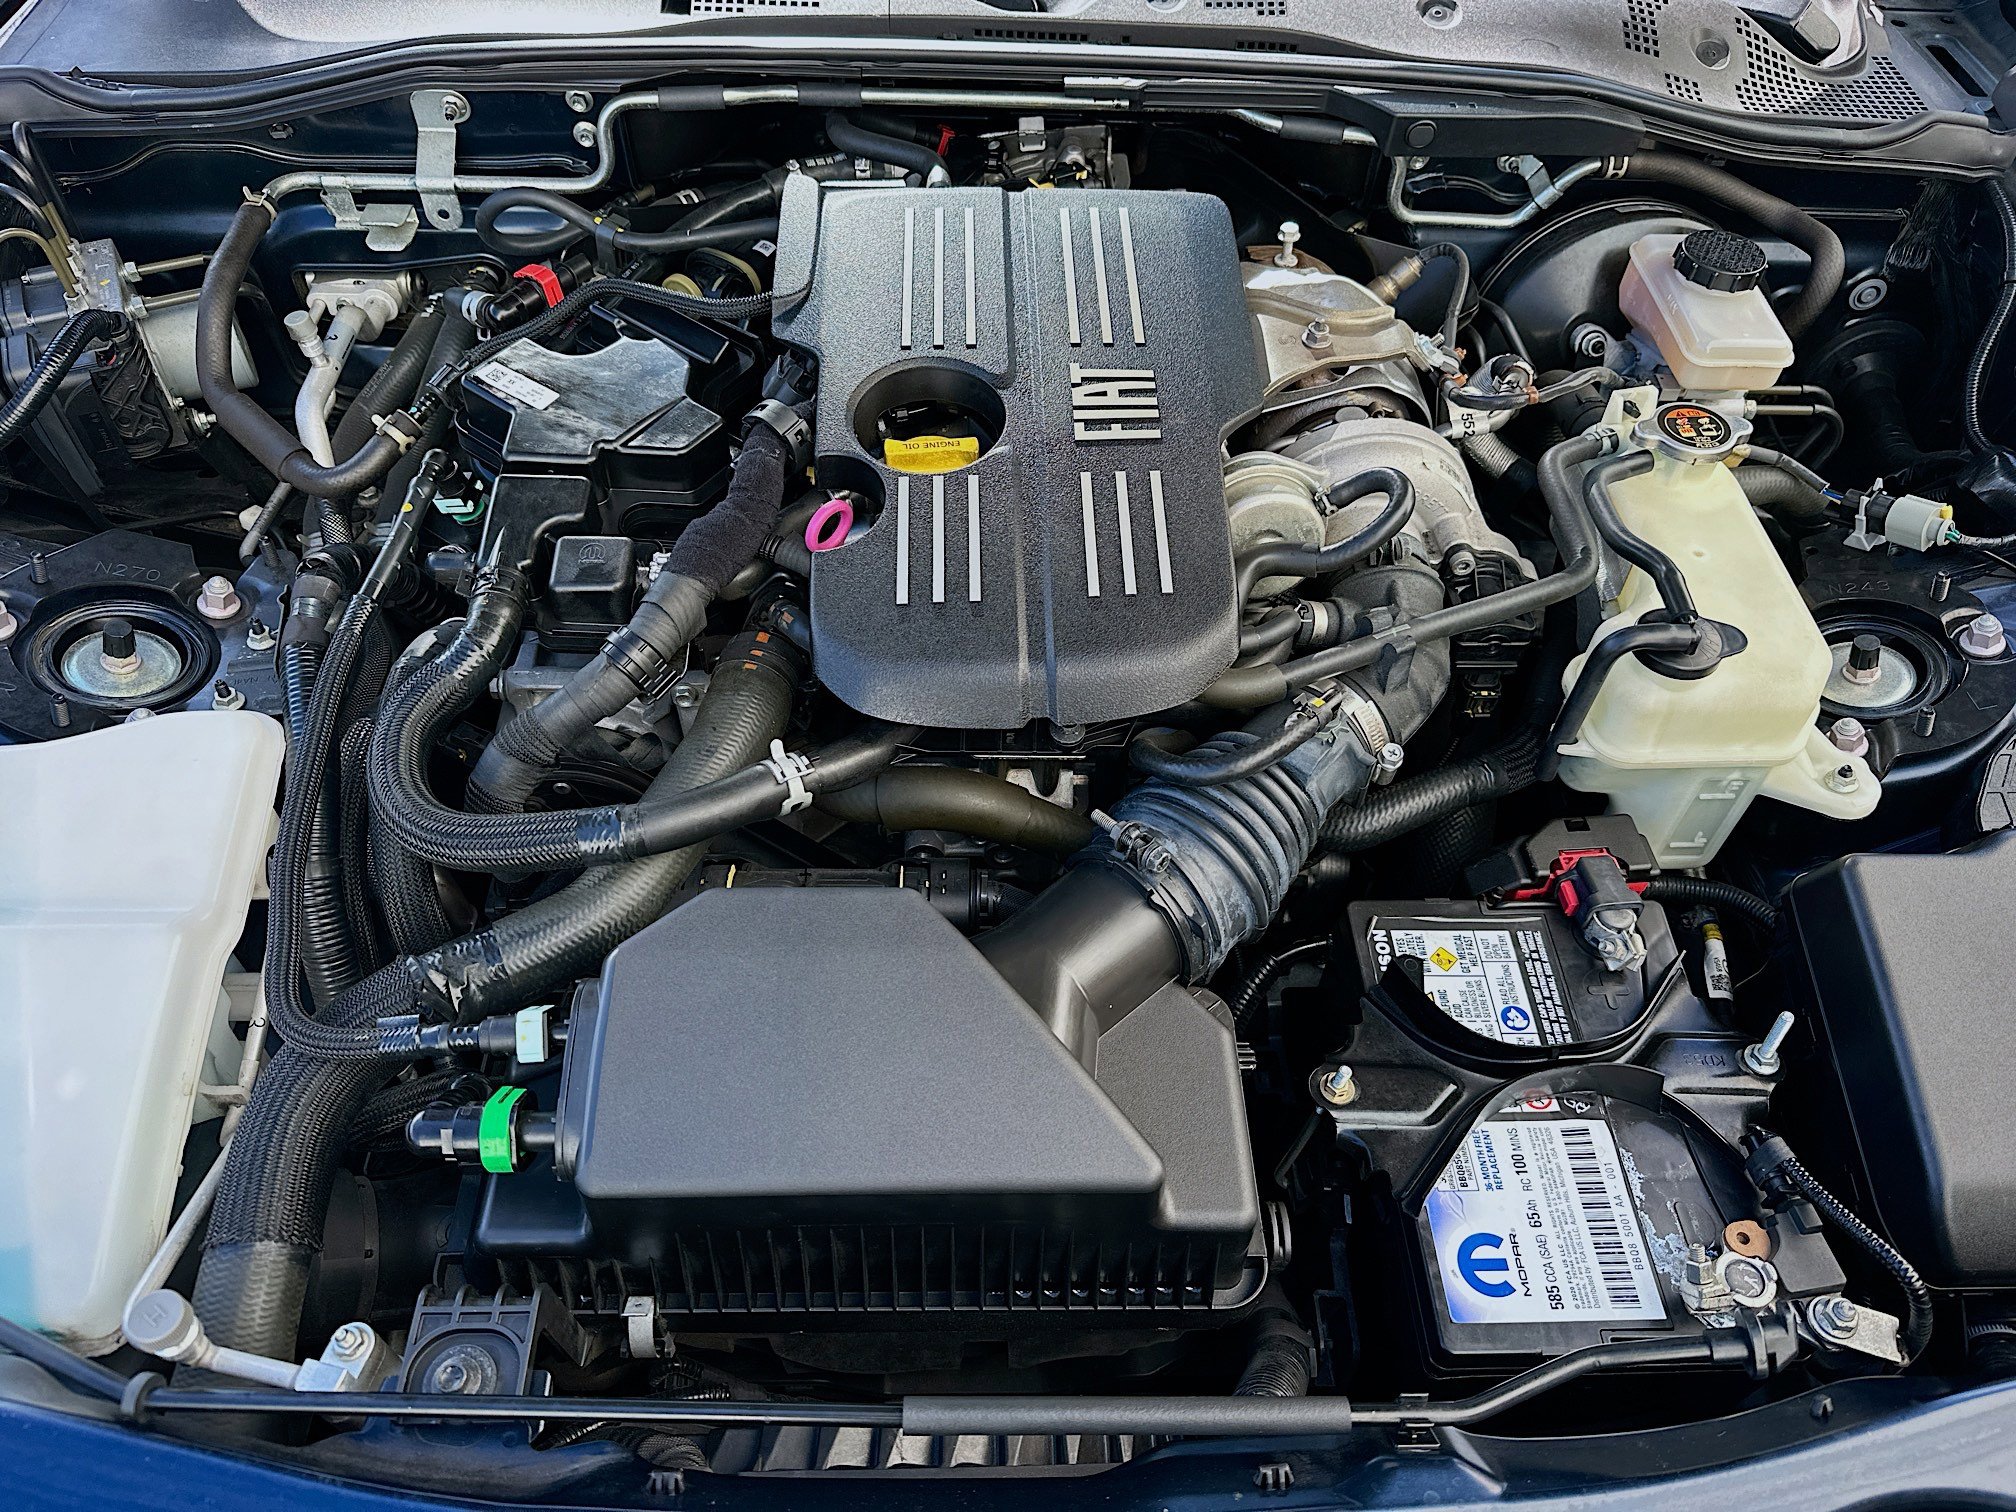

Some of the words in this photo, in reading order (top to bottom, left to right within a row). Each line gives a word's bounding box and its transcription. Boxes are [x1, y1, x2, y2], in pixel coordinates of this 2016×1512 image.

[1069, 362, 1161, 440] FIAT
[1461, 413, 1475, 438] 552
[901, 442, 919, 450] OIL
[921, 440, 960, 449] ENGINE
[94, 560, 161, 581] N270
[1828, 580, 1889, 594] N243
[1395, 938, 1406, 953] EYES
[1414, 933, 1426, 956] WATER.
[1453, 934, 1465, 960] MEDICAL
[1463, 935, 1473, 951] FAST
[1480, 938, 1490, 949] NOT
[1524, 930, 1536, 951] VEHICLE
[1468, 951, 1478, 967] HELP
[1485, 950, 1493, 959] DO
[1492, 943, 1501, 959] OPEN
[1459, 961, 1470, 974] GET
[1542, 962, 1553, 976] SEEK
[1465, 980, 1474, 989] OR
[1496, 976, 1504, 988] ALL
[1528, 976, 1538, 988] AND
[1534, 960, 1550, 997] INSTRUCTIONS
[1474, 979, 1484, 998] BURNS
[1500, 988, 1509, 1005] READ
[1458, 989, 1469, 1007] CAUSE
[1467, 989, 1482, 1018] BLINDNESS
[1453, 1003, 1463, 1018] ACID
[1463, 1007, 1472, 1018] CAN
[1480, 998, 1491, 1018] SEVERE
[1537, 1004, 1547, 1018] CAPS
[1544, 998, 1558, 1021] FOLLOW
[1554, 1005, 1565, 1017] NOT
[1561, 1023, 1568, 1032] OR
[1471, 1129, 1482, 1148] FREE
[1507, 1127, 1521, 1151] MINS
[1544, 1126, 1553, 1145] 48326
[1481, 1129, 1503, 1190] REPLACEMENT
[1511, 1154, 1527, 1176] 100
[1465, 1165, 1473, 1180] PART
[1476, 1150, 1493, 1192] 36-MONTH
[1604, 1162, 1615, 1180] 001
[1520, 1178, 1532, 1192] RC
[1613, 1194, 1624, 1208] AA
[1565, 1204, 1577, 1226] Auburn
[1572, 1226, 1580, 1239] LLC,
[1619, 1213, 1633, 1237] 5001
[1535, 1234, 1552, 1260] (SAE)
[1576, 1240, 1583, 1250] US
[1509, 1233, 1531, 1297] MOPAR
[1561, 1259, 1568, 1268] US
[1627, 1243, 1643, 1270] BBQ8
[1543, 1261, 1556, 1283] CCA
[1565, 1270, 1573, 1284] FCA
[1545, 1285, 1564, 1310] 585
[1569, 1286, 1577, 1301] 2020
[1587, 1275, 1600, 1309] Distributed
